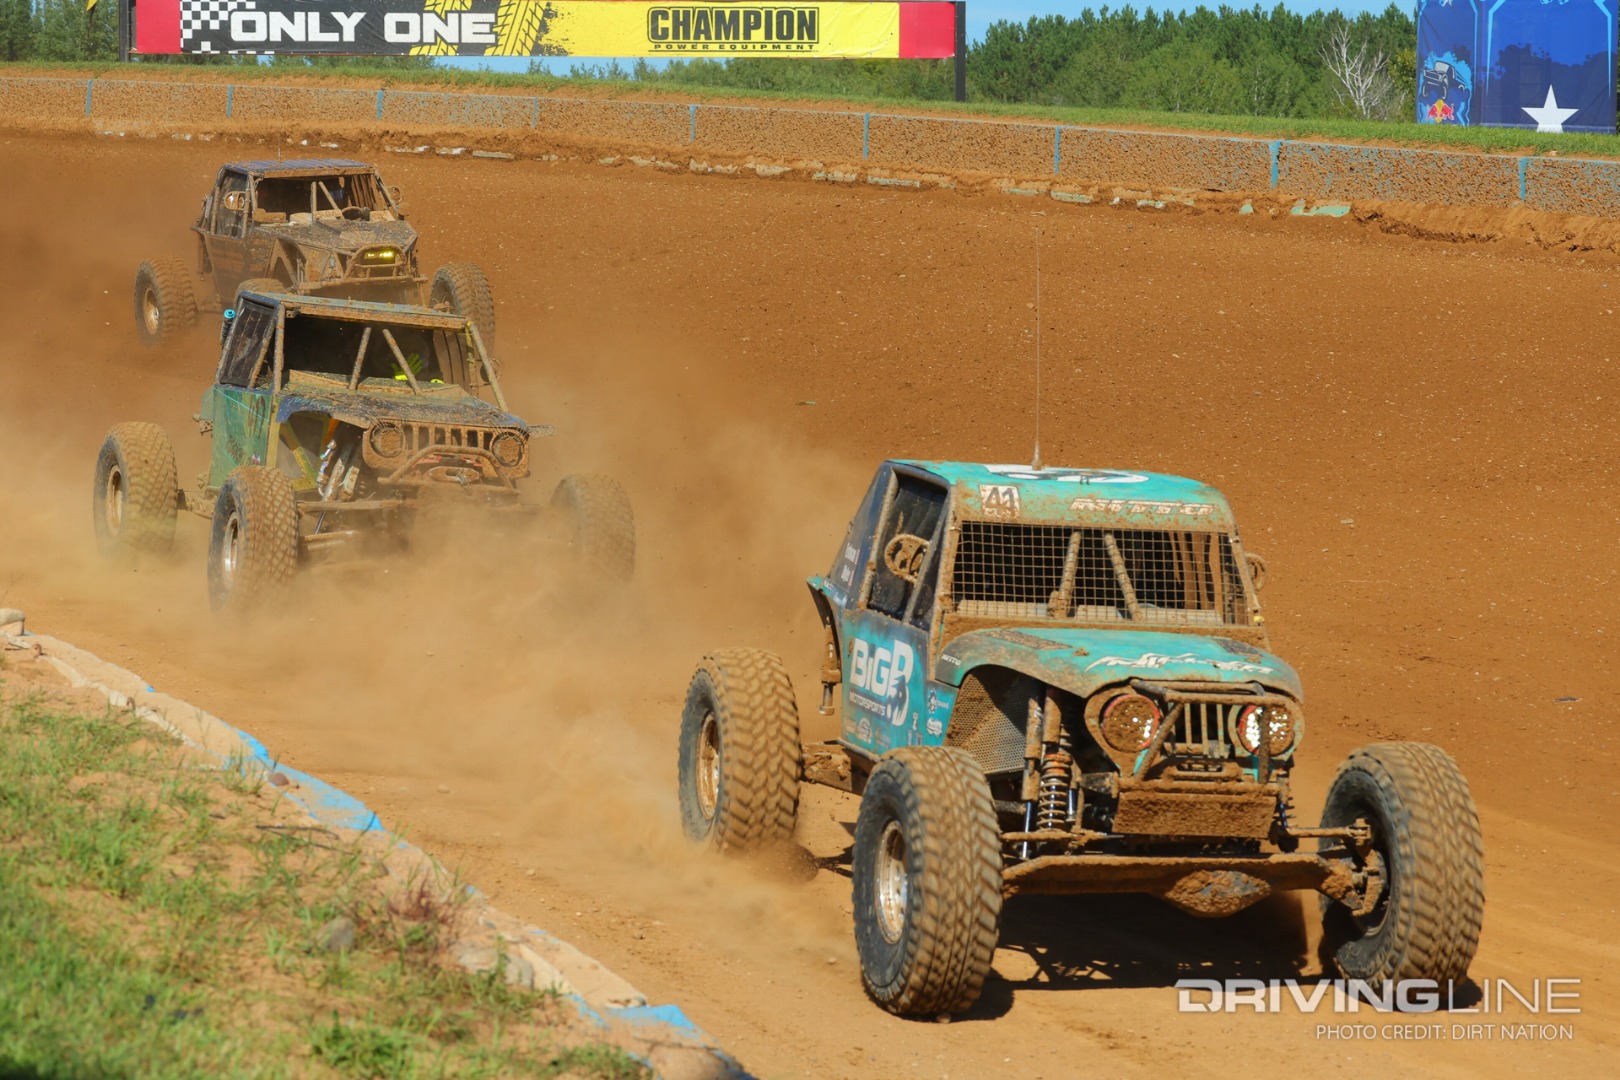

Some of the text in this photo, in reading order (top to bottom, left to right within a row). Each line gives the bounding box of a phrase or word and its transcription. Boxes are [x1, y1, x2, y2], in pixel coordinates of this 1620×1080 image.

[230, 11, 497, 44] ONLY ONE
[649, 8, 817, 41] CHAMPION
[718, 43, 815, 51] EQUIPMENT
[985, 486, 1016, 517] 41
